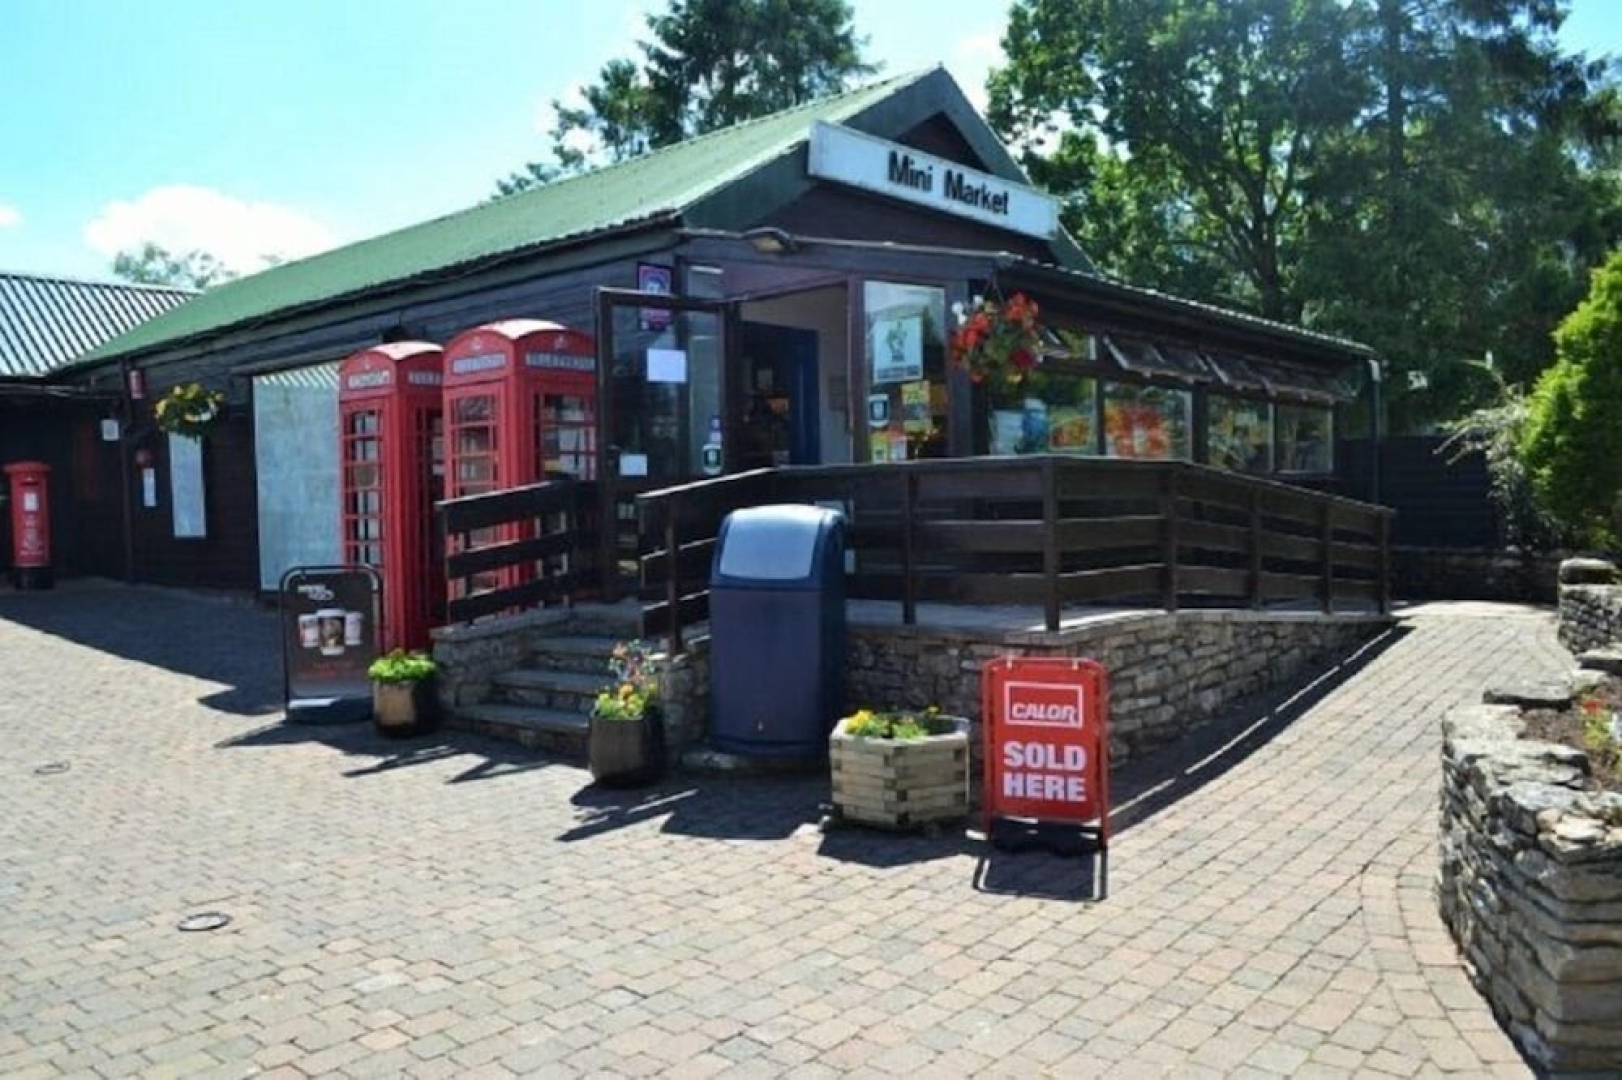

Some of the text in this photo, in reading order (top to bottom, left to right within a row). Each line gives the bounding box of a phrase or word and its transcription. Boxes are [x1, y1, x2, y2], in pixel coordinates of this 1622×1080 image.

[887, 150, 1009, 215] Mini Market
[1012, 702, 1077, 724] CALOR
[1003, 740, 1087, 771] SOLD
[1003, 771, 1087, 802] HERE
